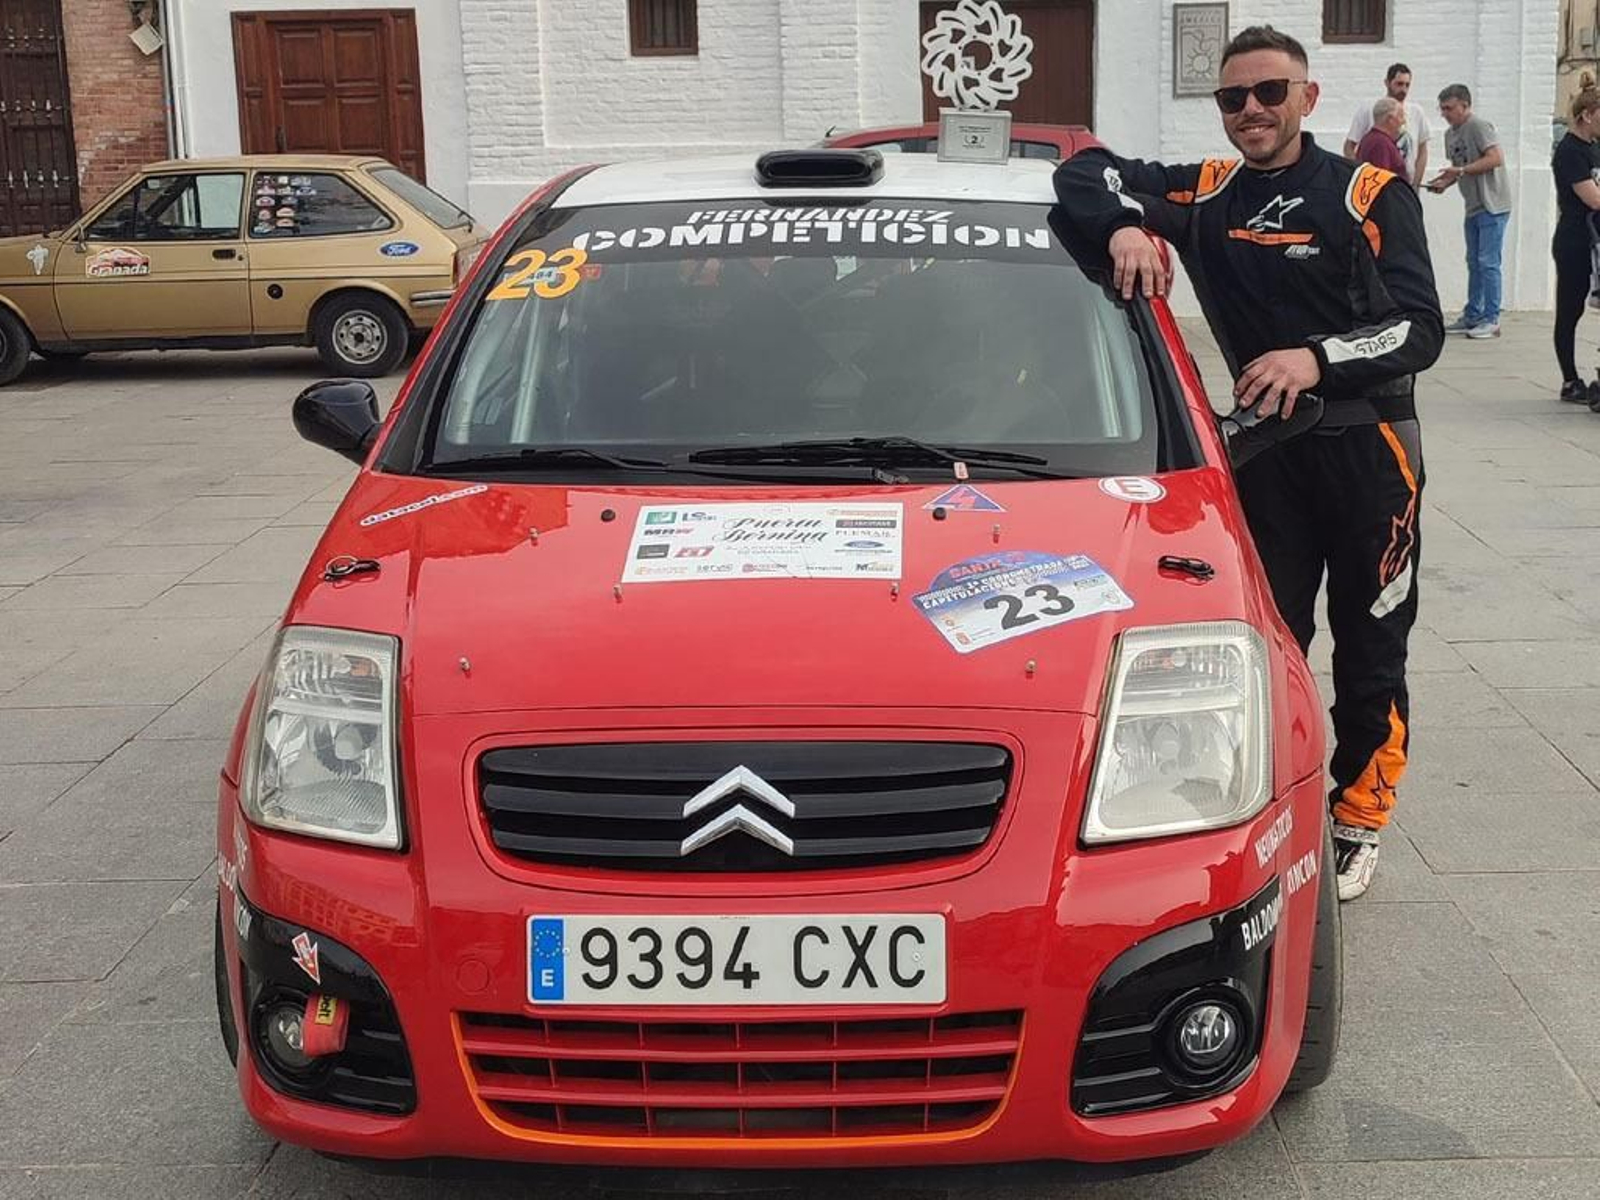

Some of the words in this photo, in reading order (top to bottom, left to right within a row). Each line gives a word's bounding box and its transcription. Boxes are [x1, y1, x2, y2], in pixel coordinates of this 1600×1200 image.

[687, 208, 953, 223] FERNANDEZ
[572, 221, 1051, 251] COMPETICION
[88, 262, 149, 276] Granada
[485, 248, 588, 300] 23
[1355, 332, 1398, 355] STARS
[983, 584, 1075, 630] 23
[580, 926, 760, 989] 9394
[793, 925, 926, 988] CXC
[541, 969, 554, 986] E
